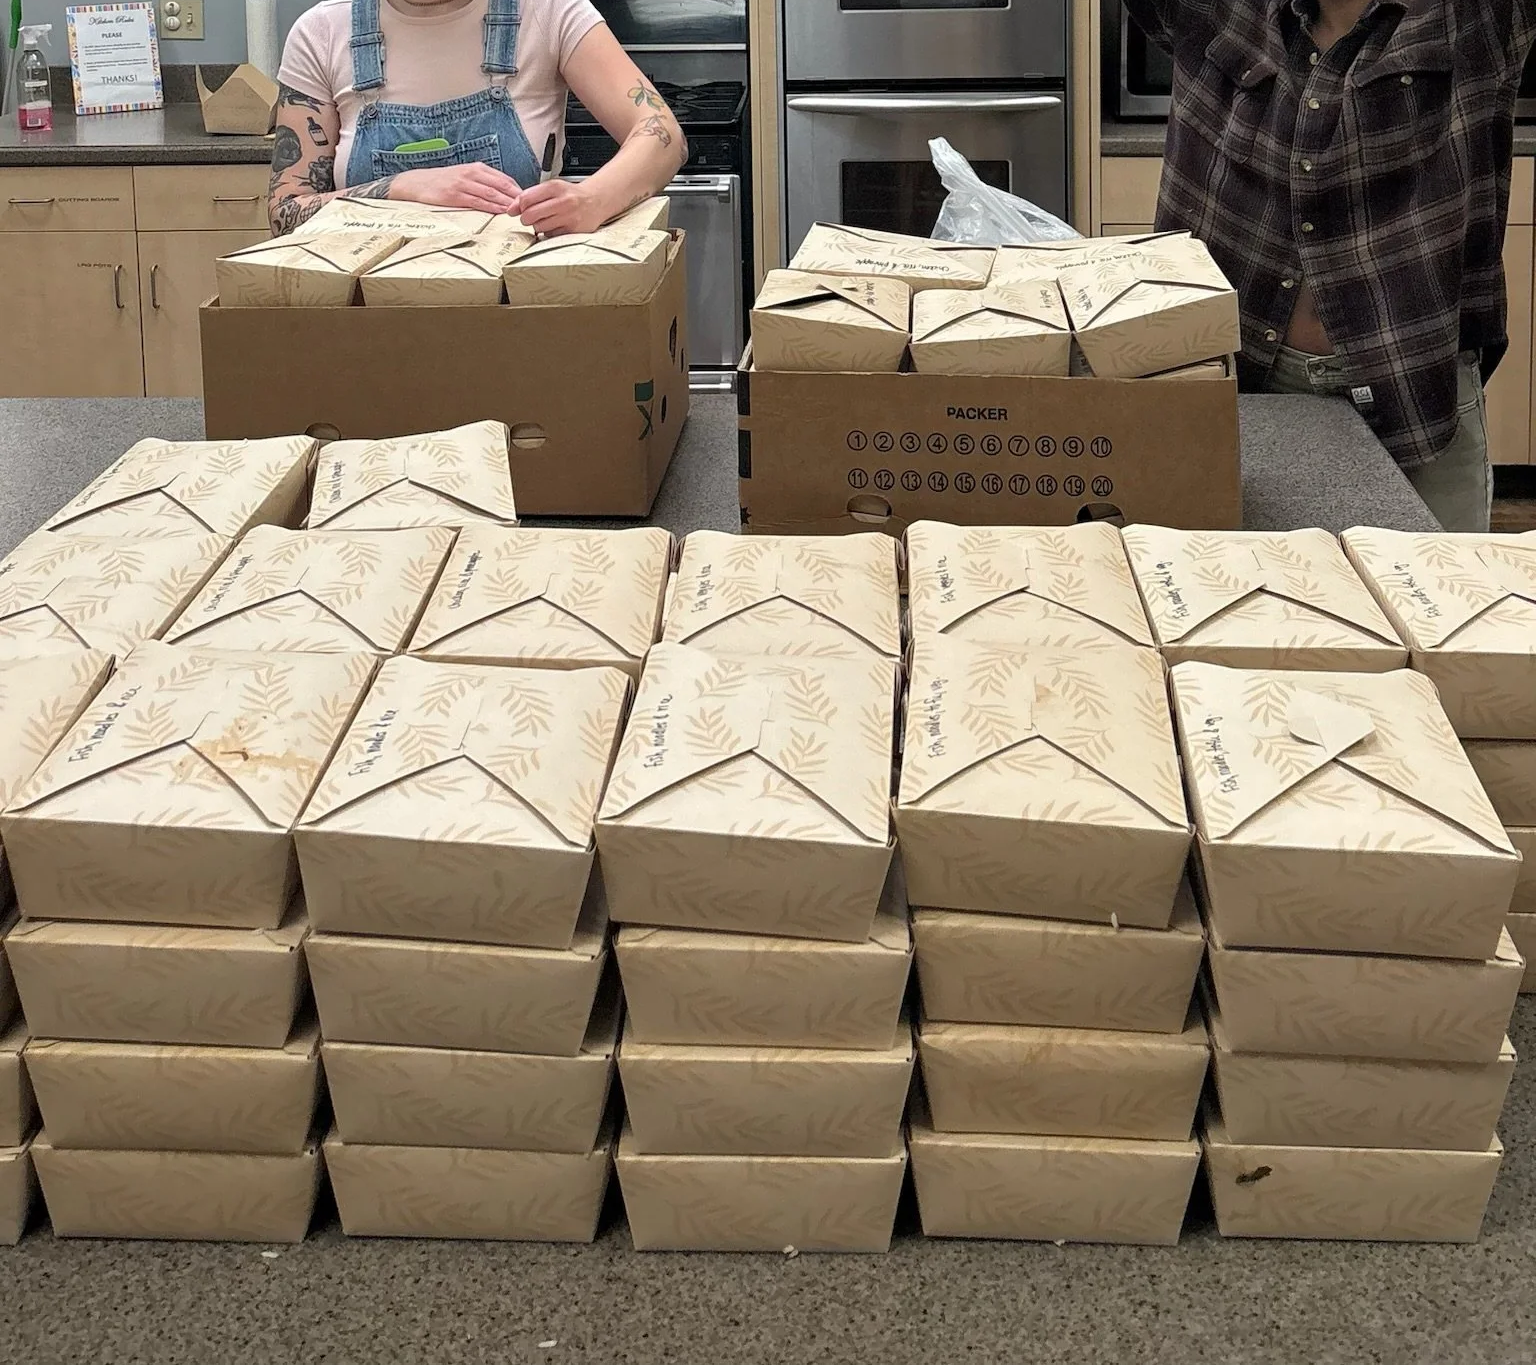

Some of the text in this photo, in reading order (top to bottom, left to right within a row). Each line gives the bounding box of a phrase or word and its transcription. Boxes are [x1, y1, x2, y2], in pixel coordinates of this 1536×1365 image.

[100, 74, 138, 85] THANKS!
[946, 406, 1009, 421] PACKER
[68, 740, 102, 762] Fish,
[120, 685, 142, 700] rice
